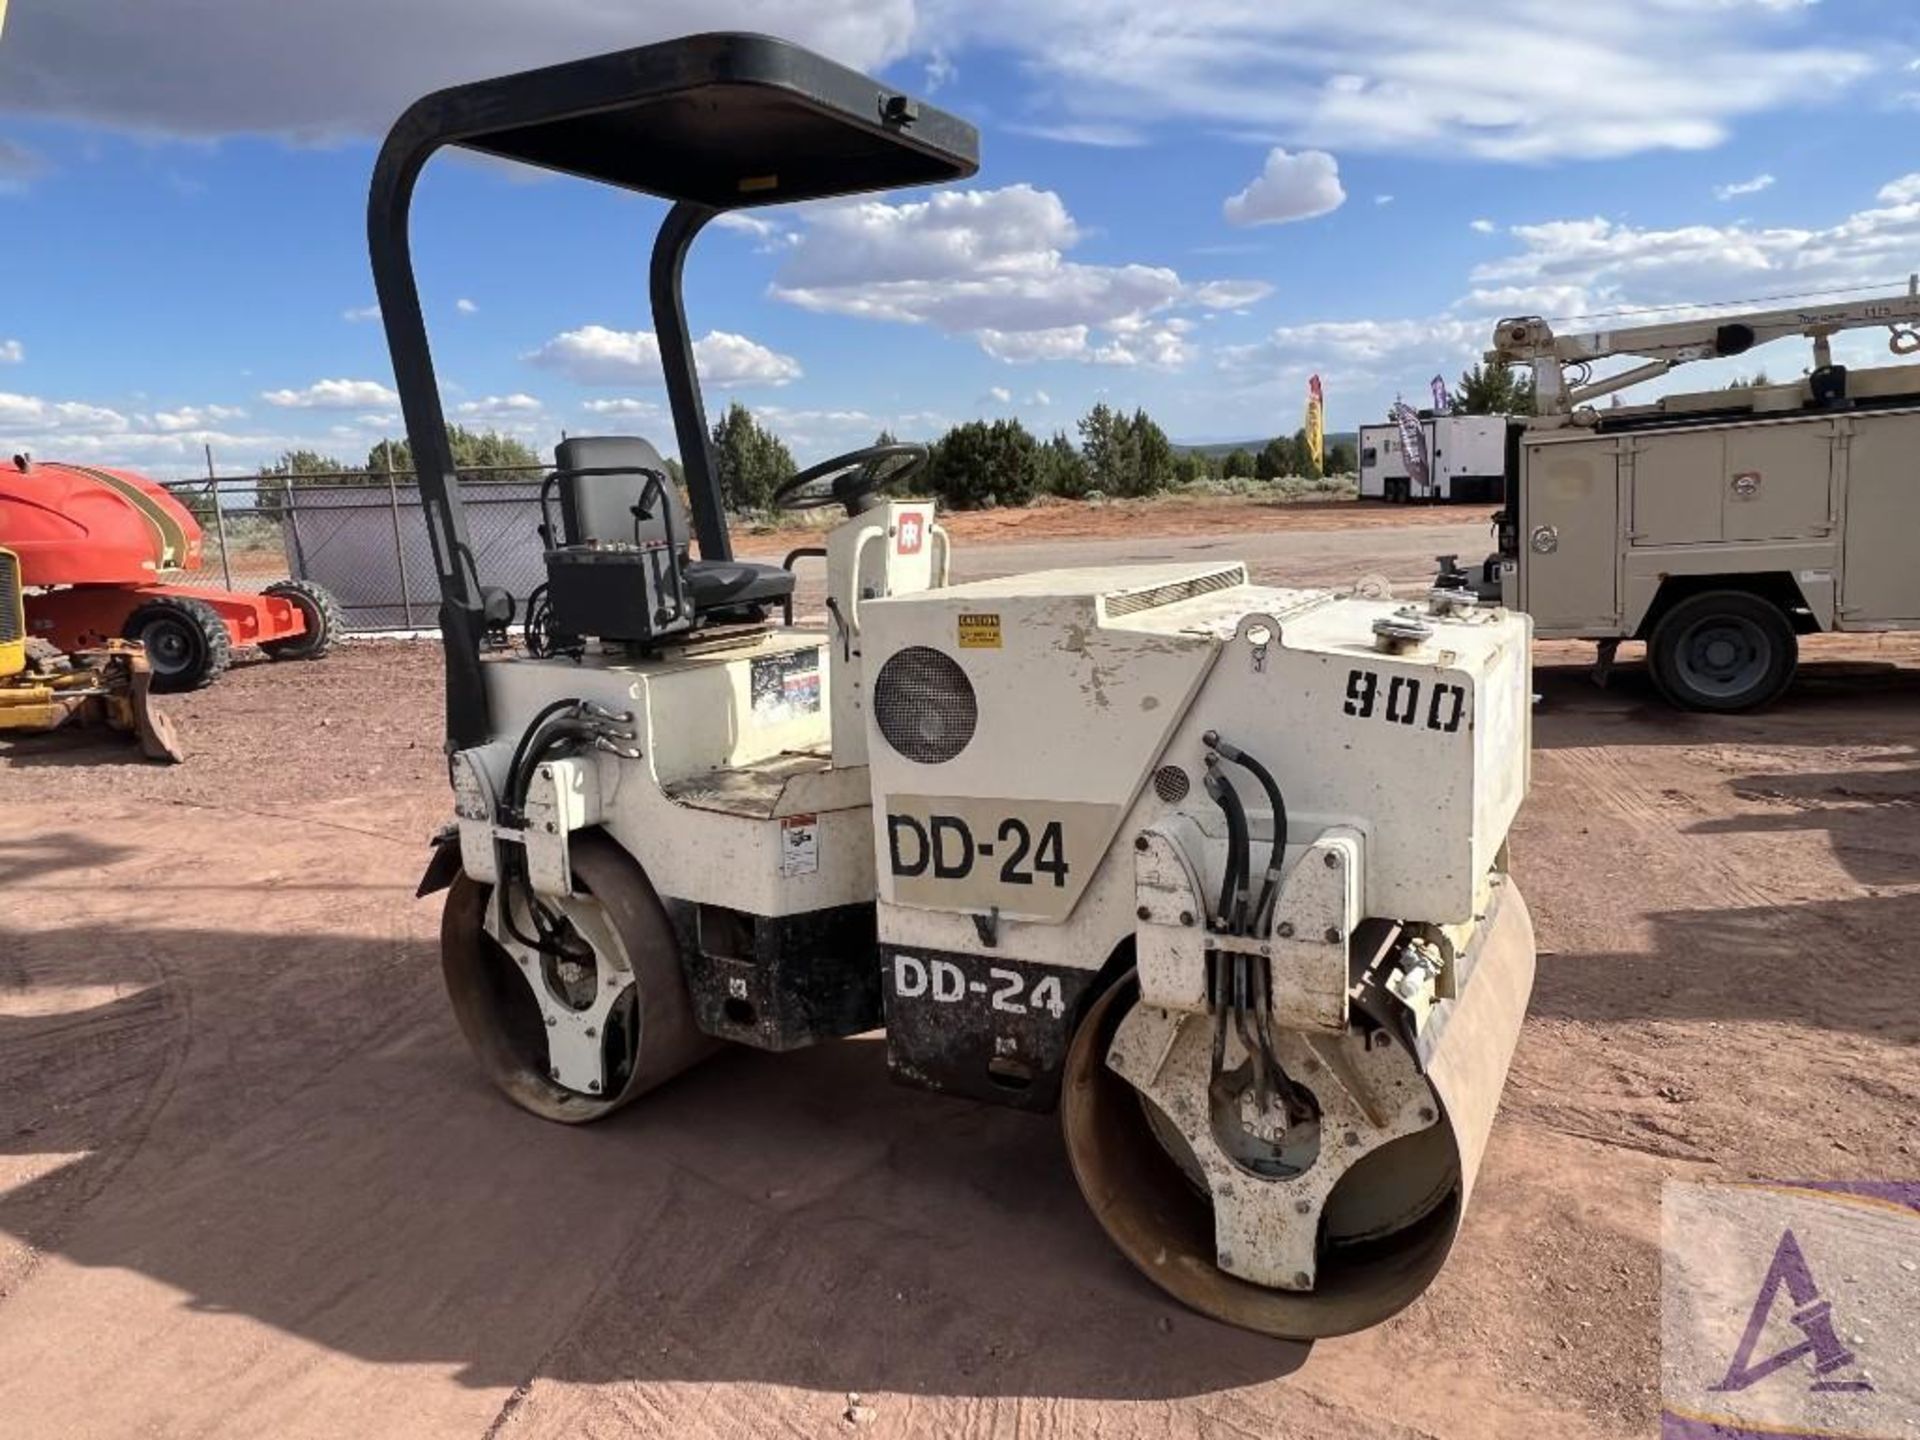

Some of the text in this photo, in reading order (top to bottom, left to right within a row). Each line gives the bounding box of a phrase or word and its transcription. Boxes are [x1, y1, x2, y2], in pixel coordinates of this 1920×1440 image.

[960, 615, 999, 625] CAUON
[1343, 669, 1465, 732] 900
[887, 814, 1069, 887] DD-24
[894, 954, 1066, 1020] DD-24
